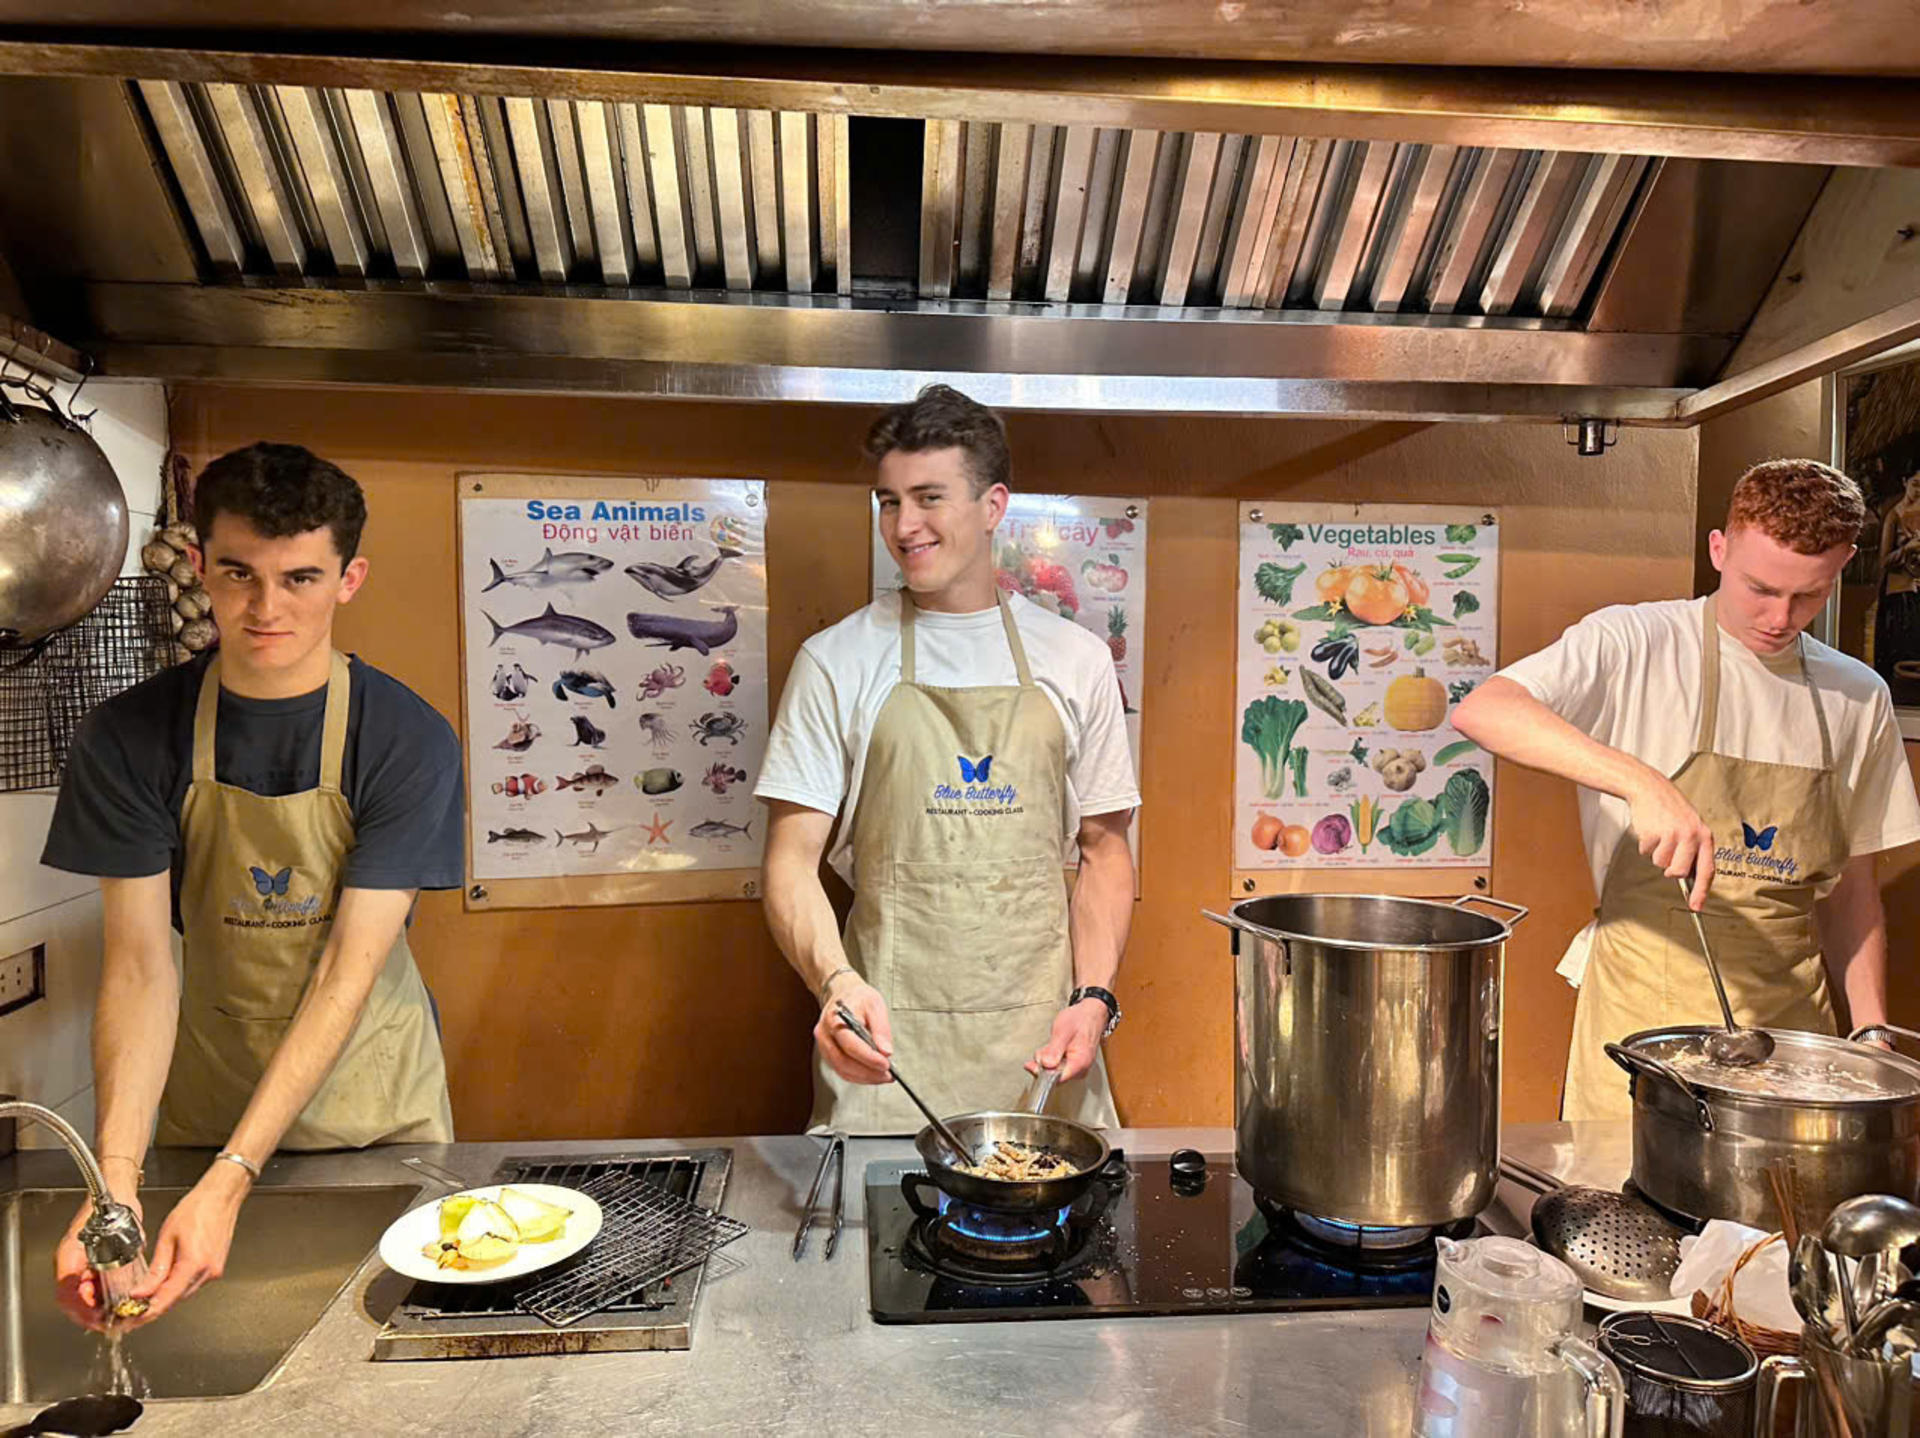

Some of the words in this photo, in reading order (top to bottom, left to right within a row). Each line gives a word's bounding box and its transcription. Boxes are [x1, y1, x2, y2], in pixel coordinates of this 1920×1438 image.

[527, 500, 581, 521] Sea
[592, 501, 706, 522] Animals
[543, 523, 598, 543] Động
[608, 524, 640, 543] vật
[650, 520, 694, 541] biển
[1059, 522, 1099, 547] cây
[1308, 524, 1436, 549] Vegetables
[934, 785, 962, 800] Blue
[966, 785, 1016, 805] Butterfly
[926, 807, 967, 816] RESTAURANT
[973, 808, 1003, 816] COOKING
[1005, 806, 1024, 815] CLASS
[1715, 847, 1743, 862] Blue
[1745, 852, 1798, 876] Butterfly
[224, 916, 266, 929] RESTAURANT
[271, 920, 306, 929] COOKING
